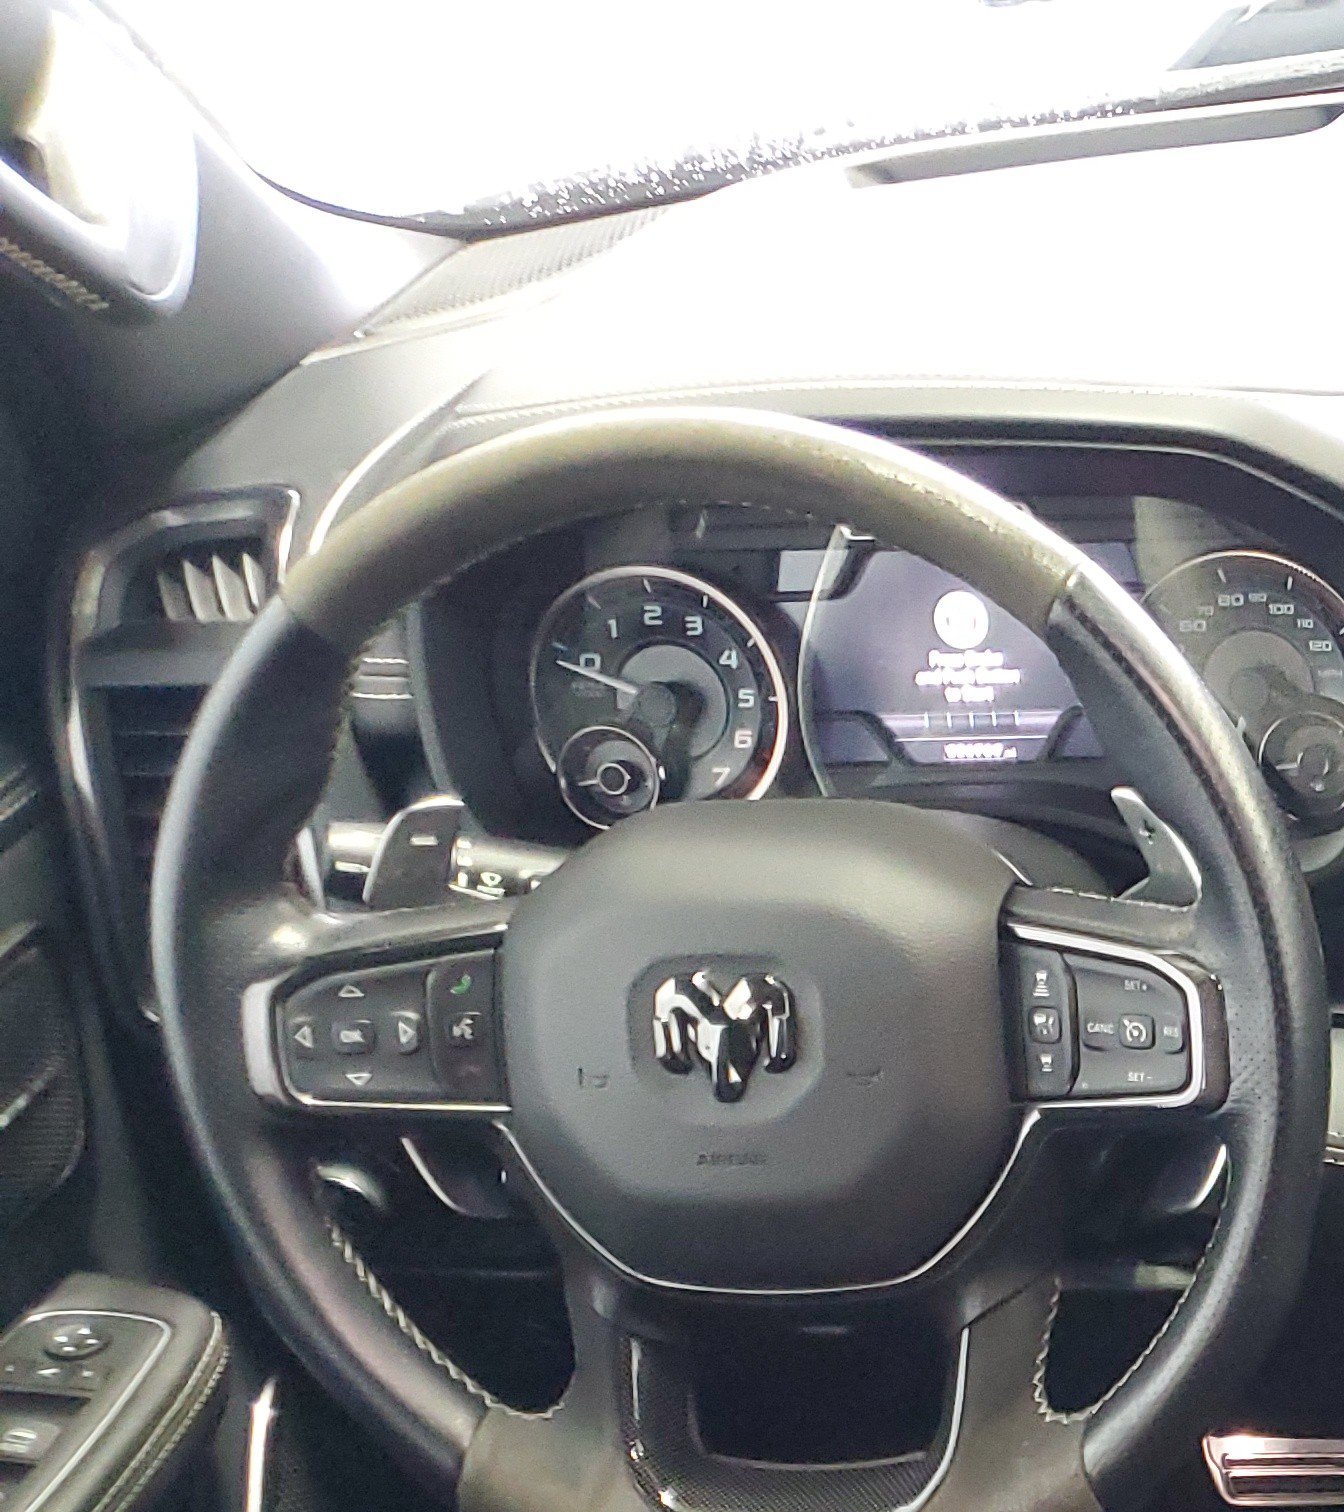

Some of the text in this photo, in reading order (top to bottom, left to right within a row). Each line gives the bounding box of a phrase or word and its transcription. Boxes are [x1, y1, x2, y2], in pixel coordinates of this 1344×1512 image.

[643, 605, 663, 625] 2
[1269, 603, 1294, 614] 100
[607, 618, 618, 638] 1
[684, 615, 703, 636] 3
[579, 652, 601, 671] 0
[719, 650, 738, 669] 4
[737, 690, 755, 707] 5
[734, 730, 752, 748] 6
[712, 767, 730, 786] 7
[1087, 1022, 1114, 1035] CANC
[1127, 1072, 1145, 1082] SET
